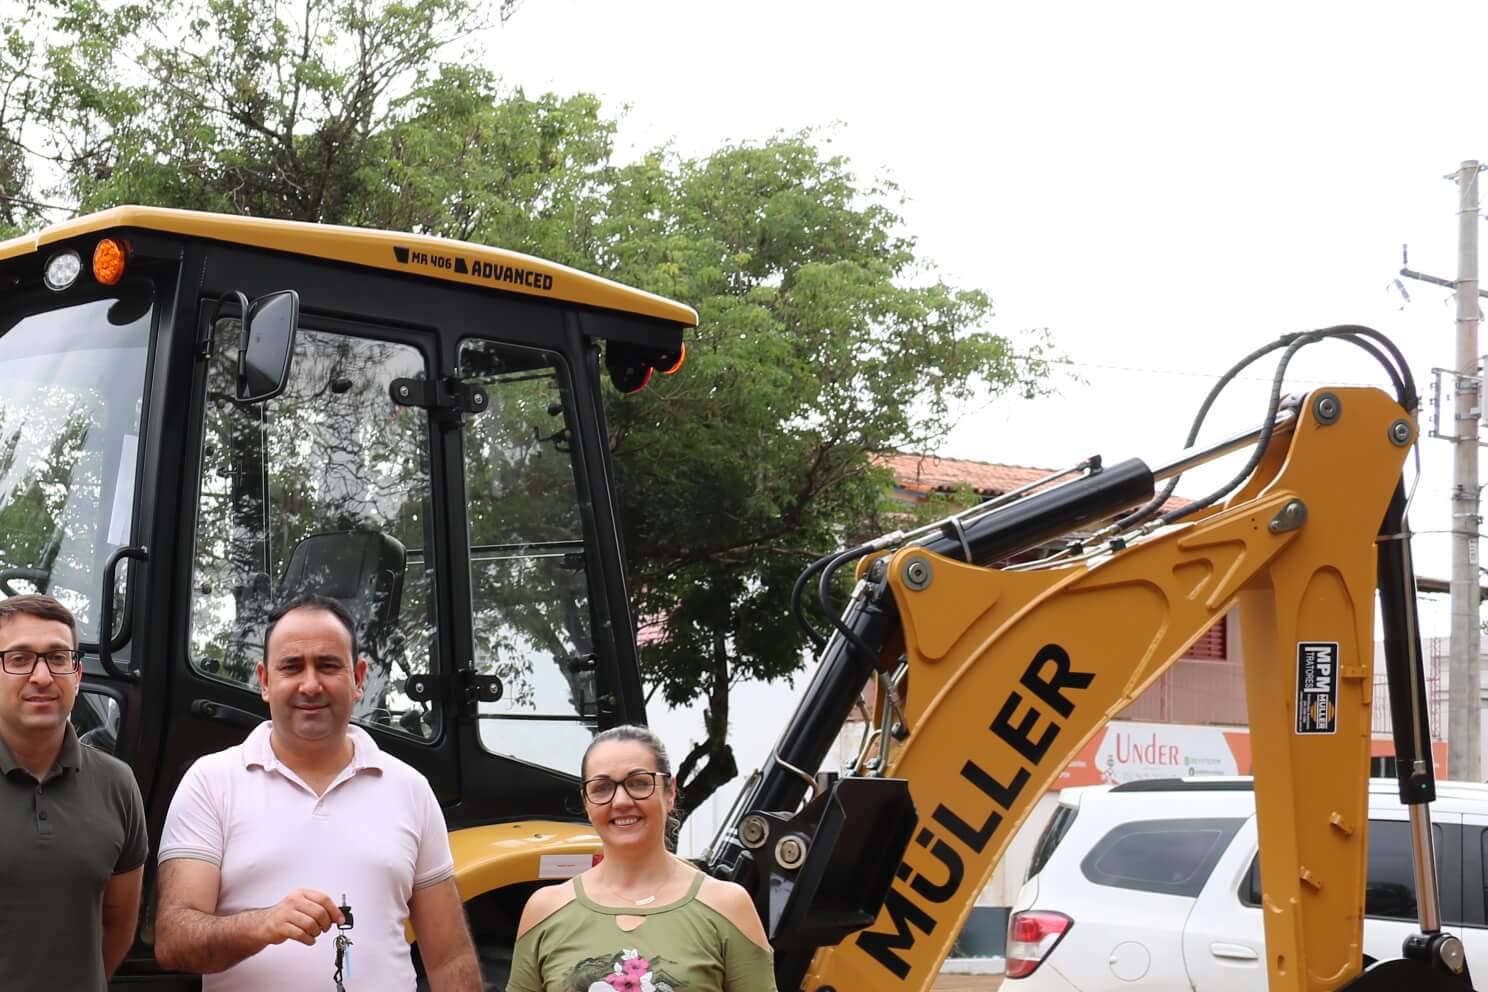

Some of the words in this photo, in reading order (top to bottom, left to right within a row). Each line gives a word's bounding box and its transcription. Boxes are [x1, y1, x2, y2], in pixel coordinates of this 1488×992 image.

[411, 252, 428, 265] MR
[430, 255, 452, 269] 406
[471, 260, 553, 291] ADVANCED
[1304, 646, 1331, 693] MPM
[1305, 652, 1315, 689] TRATORES
[855, 643, 1096, 981] MÜLLER
